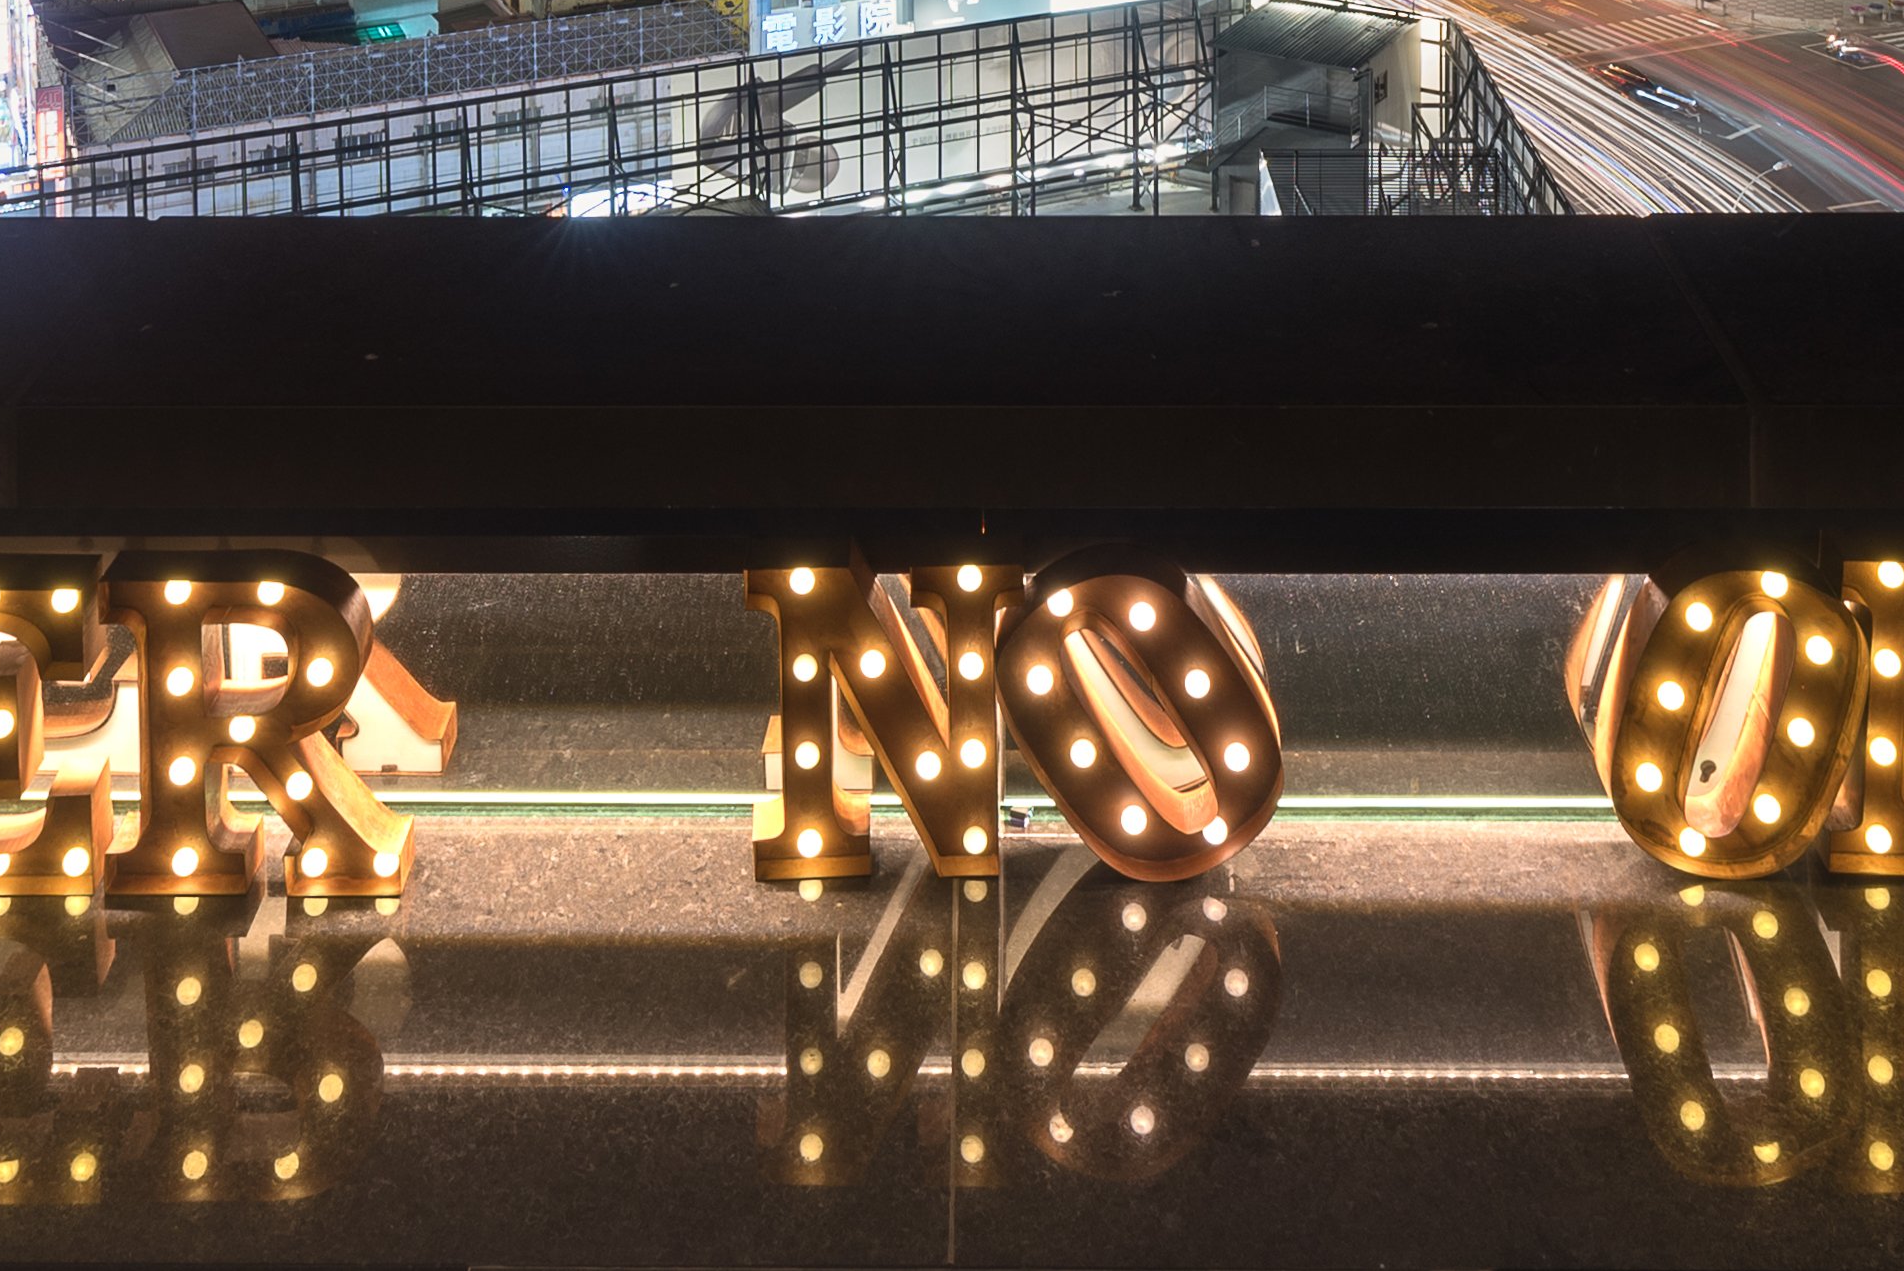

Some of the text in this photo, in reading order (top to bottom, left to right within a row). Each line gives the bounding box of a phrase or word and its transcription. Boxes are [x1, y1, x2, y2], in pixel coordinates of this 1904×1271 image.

[762, 0, 898, 53] 電影院
[745, 548, 1284, 883] NO
